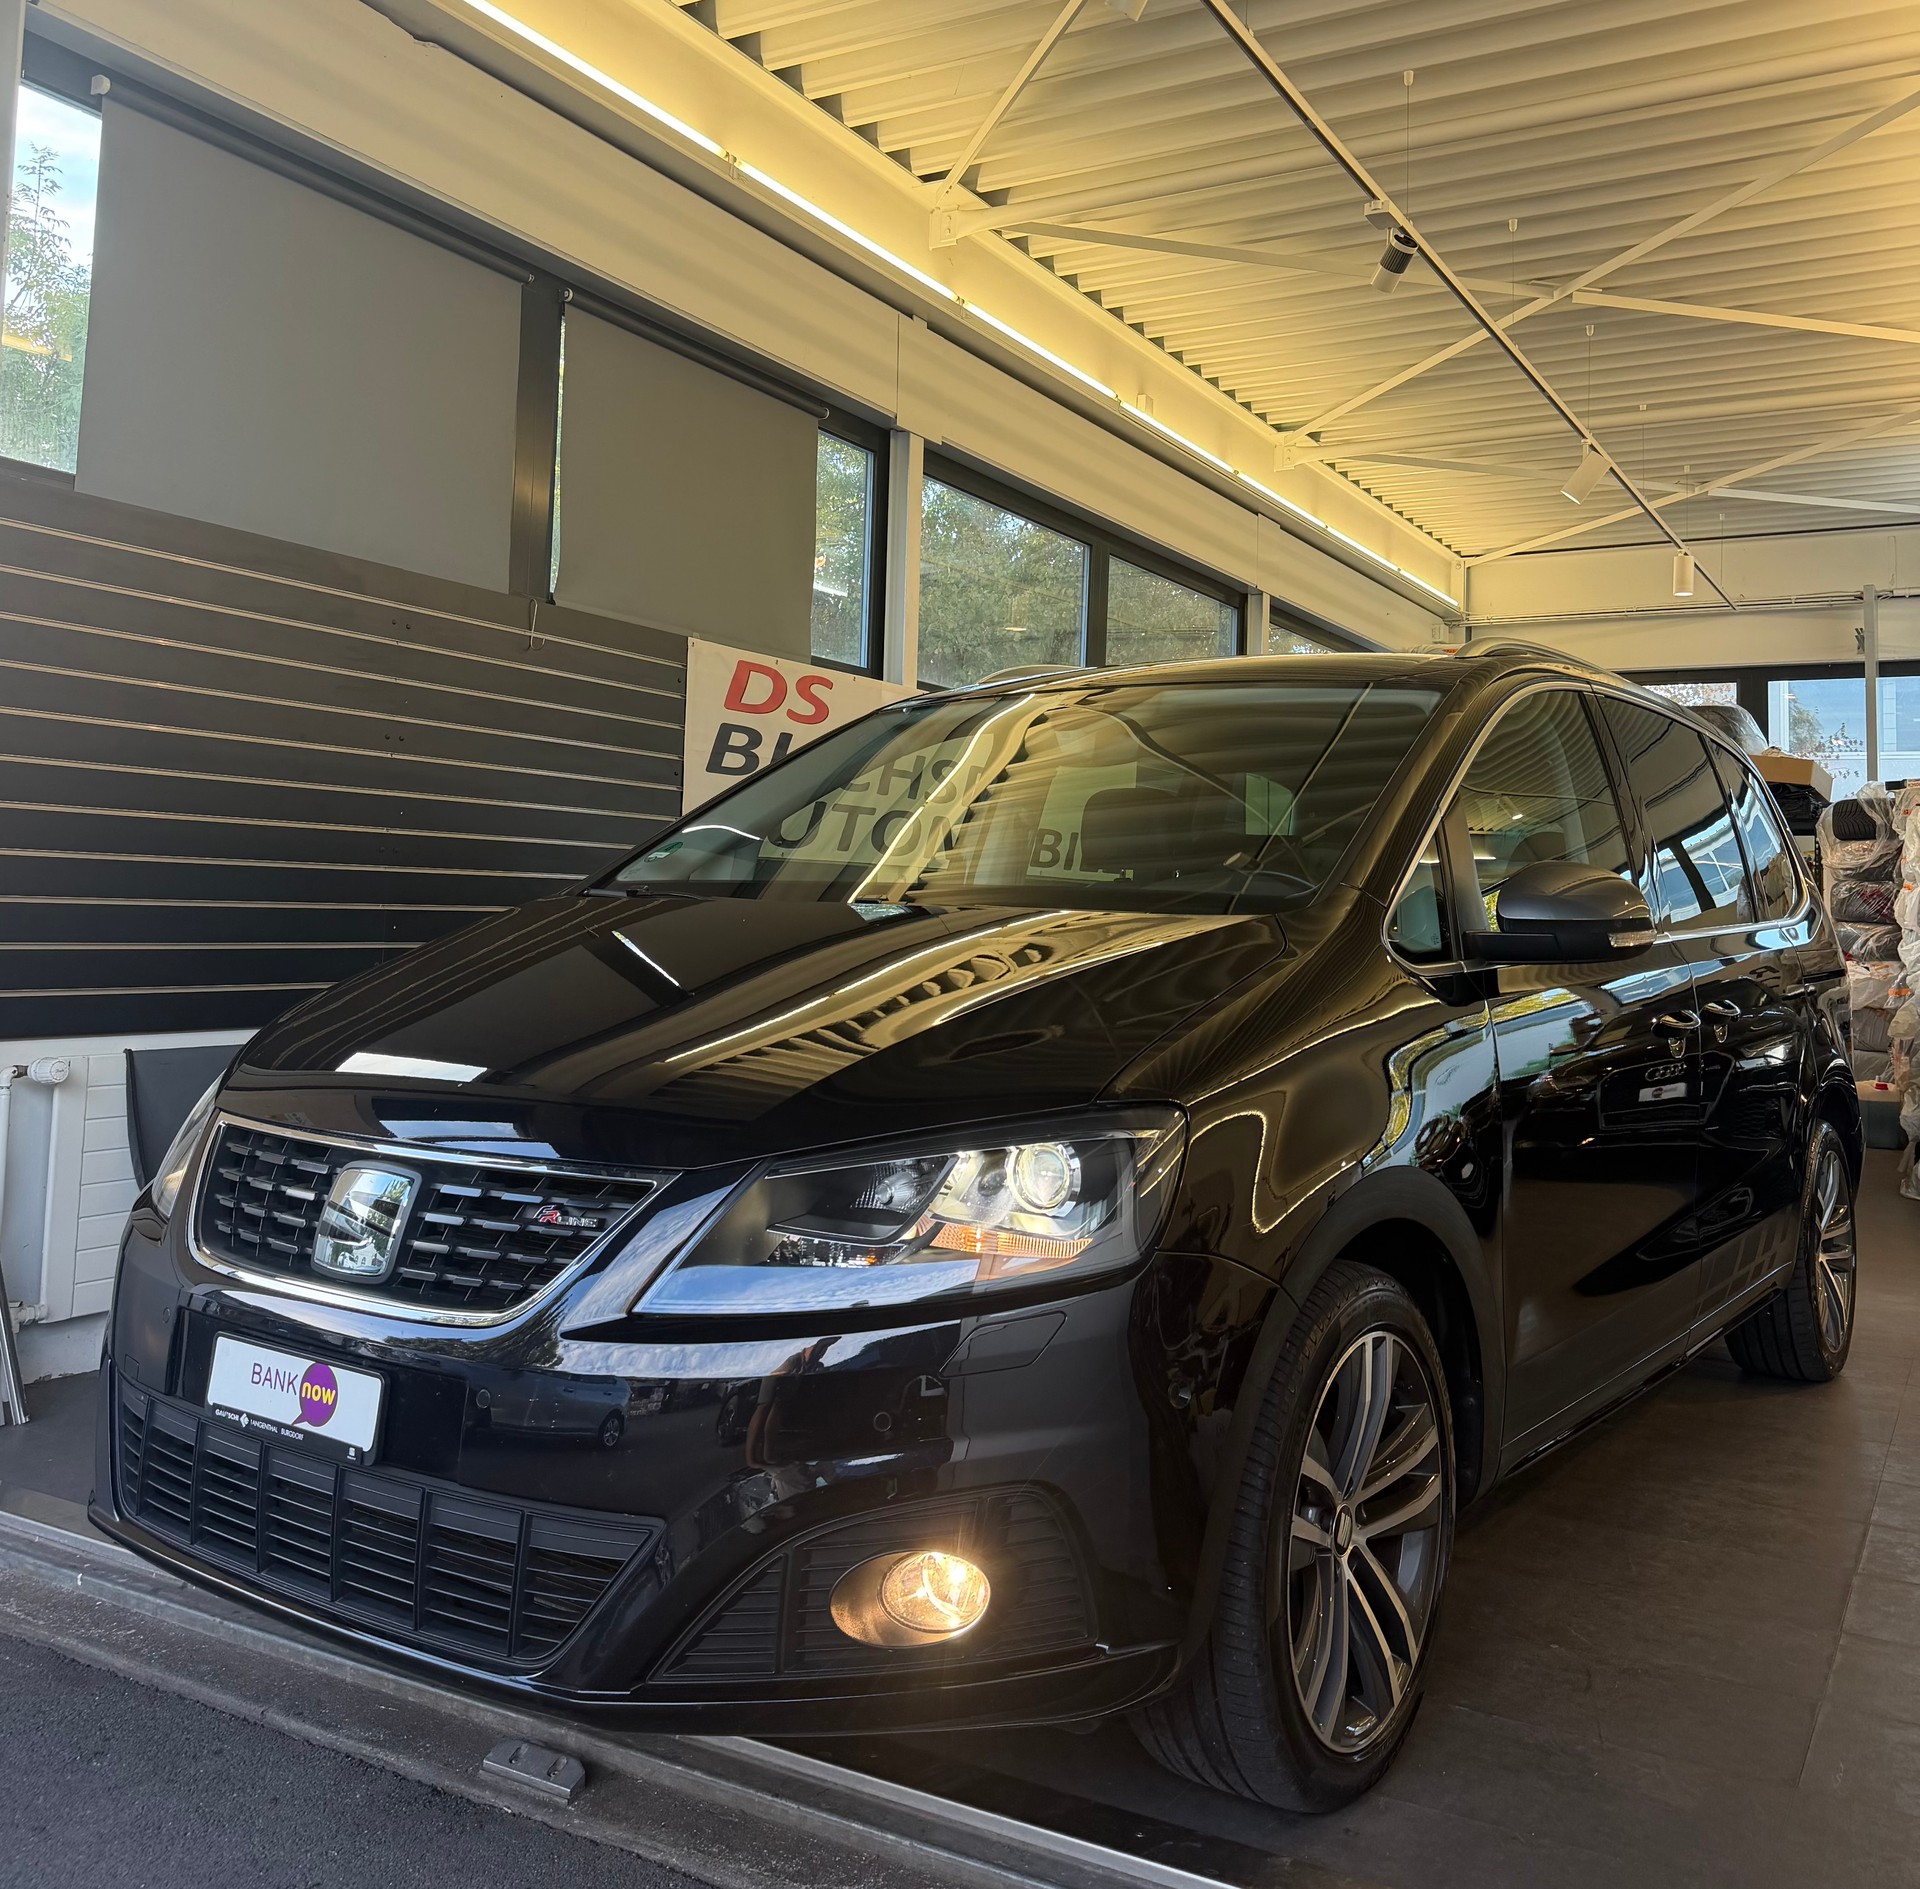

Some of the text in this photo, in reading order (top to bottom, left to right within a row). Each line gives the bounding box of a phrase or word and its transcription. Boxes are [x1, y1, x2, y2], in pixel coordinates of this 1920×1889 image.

[724, 660, 834, 725] DS
[557, 1216, 598, 1228] LINE
[250, 1362, 336, 1406] BANK now
[280, 1427, 304, 1441] BURGDORF
